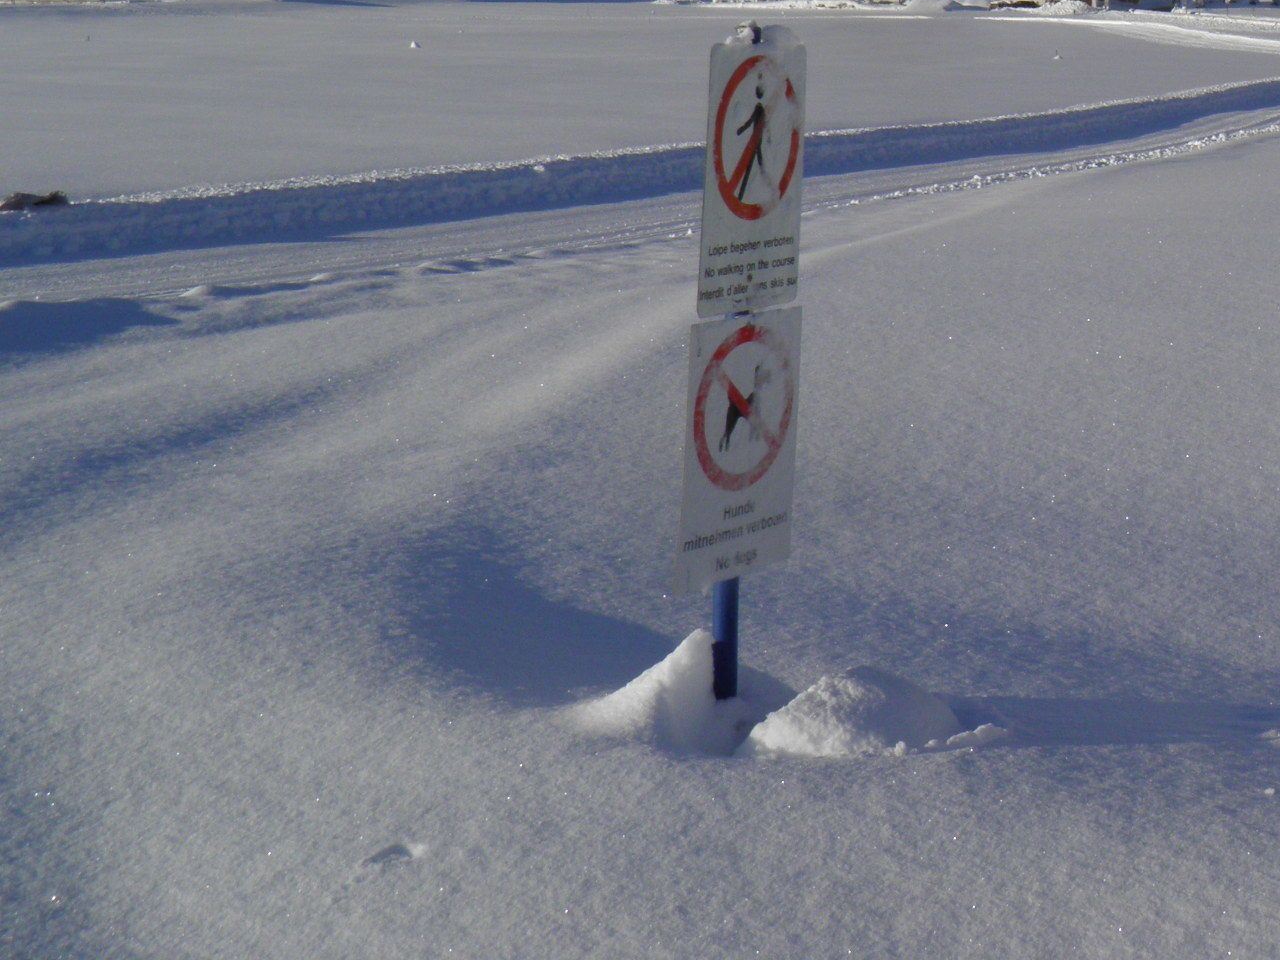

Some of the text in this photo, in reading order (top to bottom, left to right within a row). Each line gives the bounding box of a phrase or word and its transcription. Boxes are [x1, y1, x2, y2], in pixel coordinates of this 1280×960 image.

[708, 236, 794, 256] Loipe begehen verboten
[704, 256, 795, 278] No walking on the course
